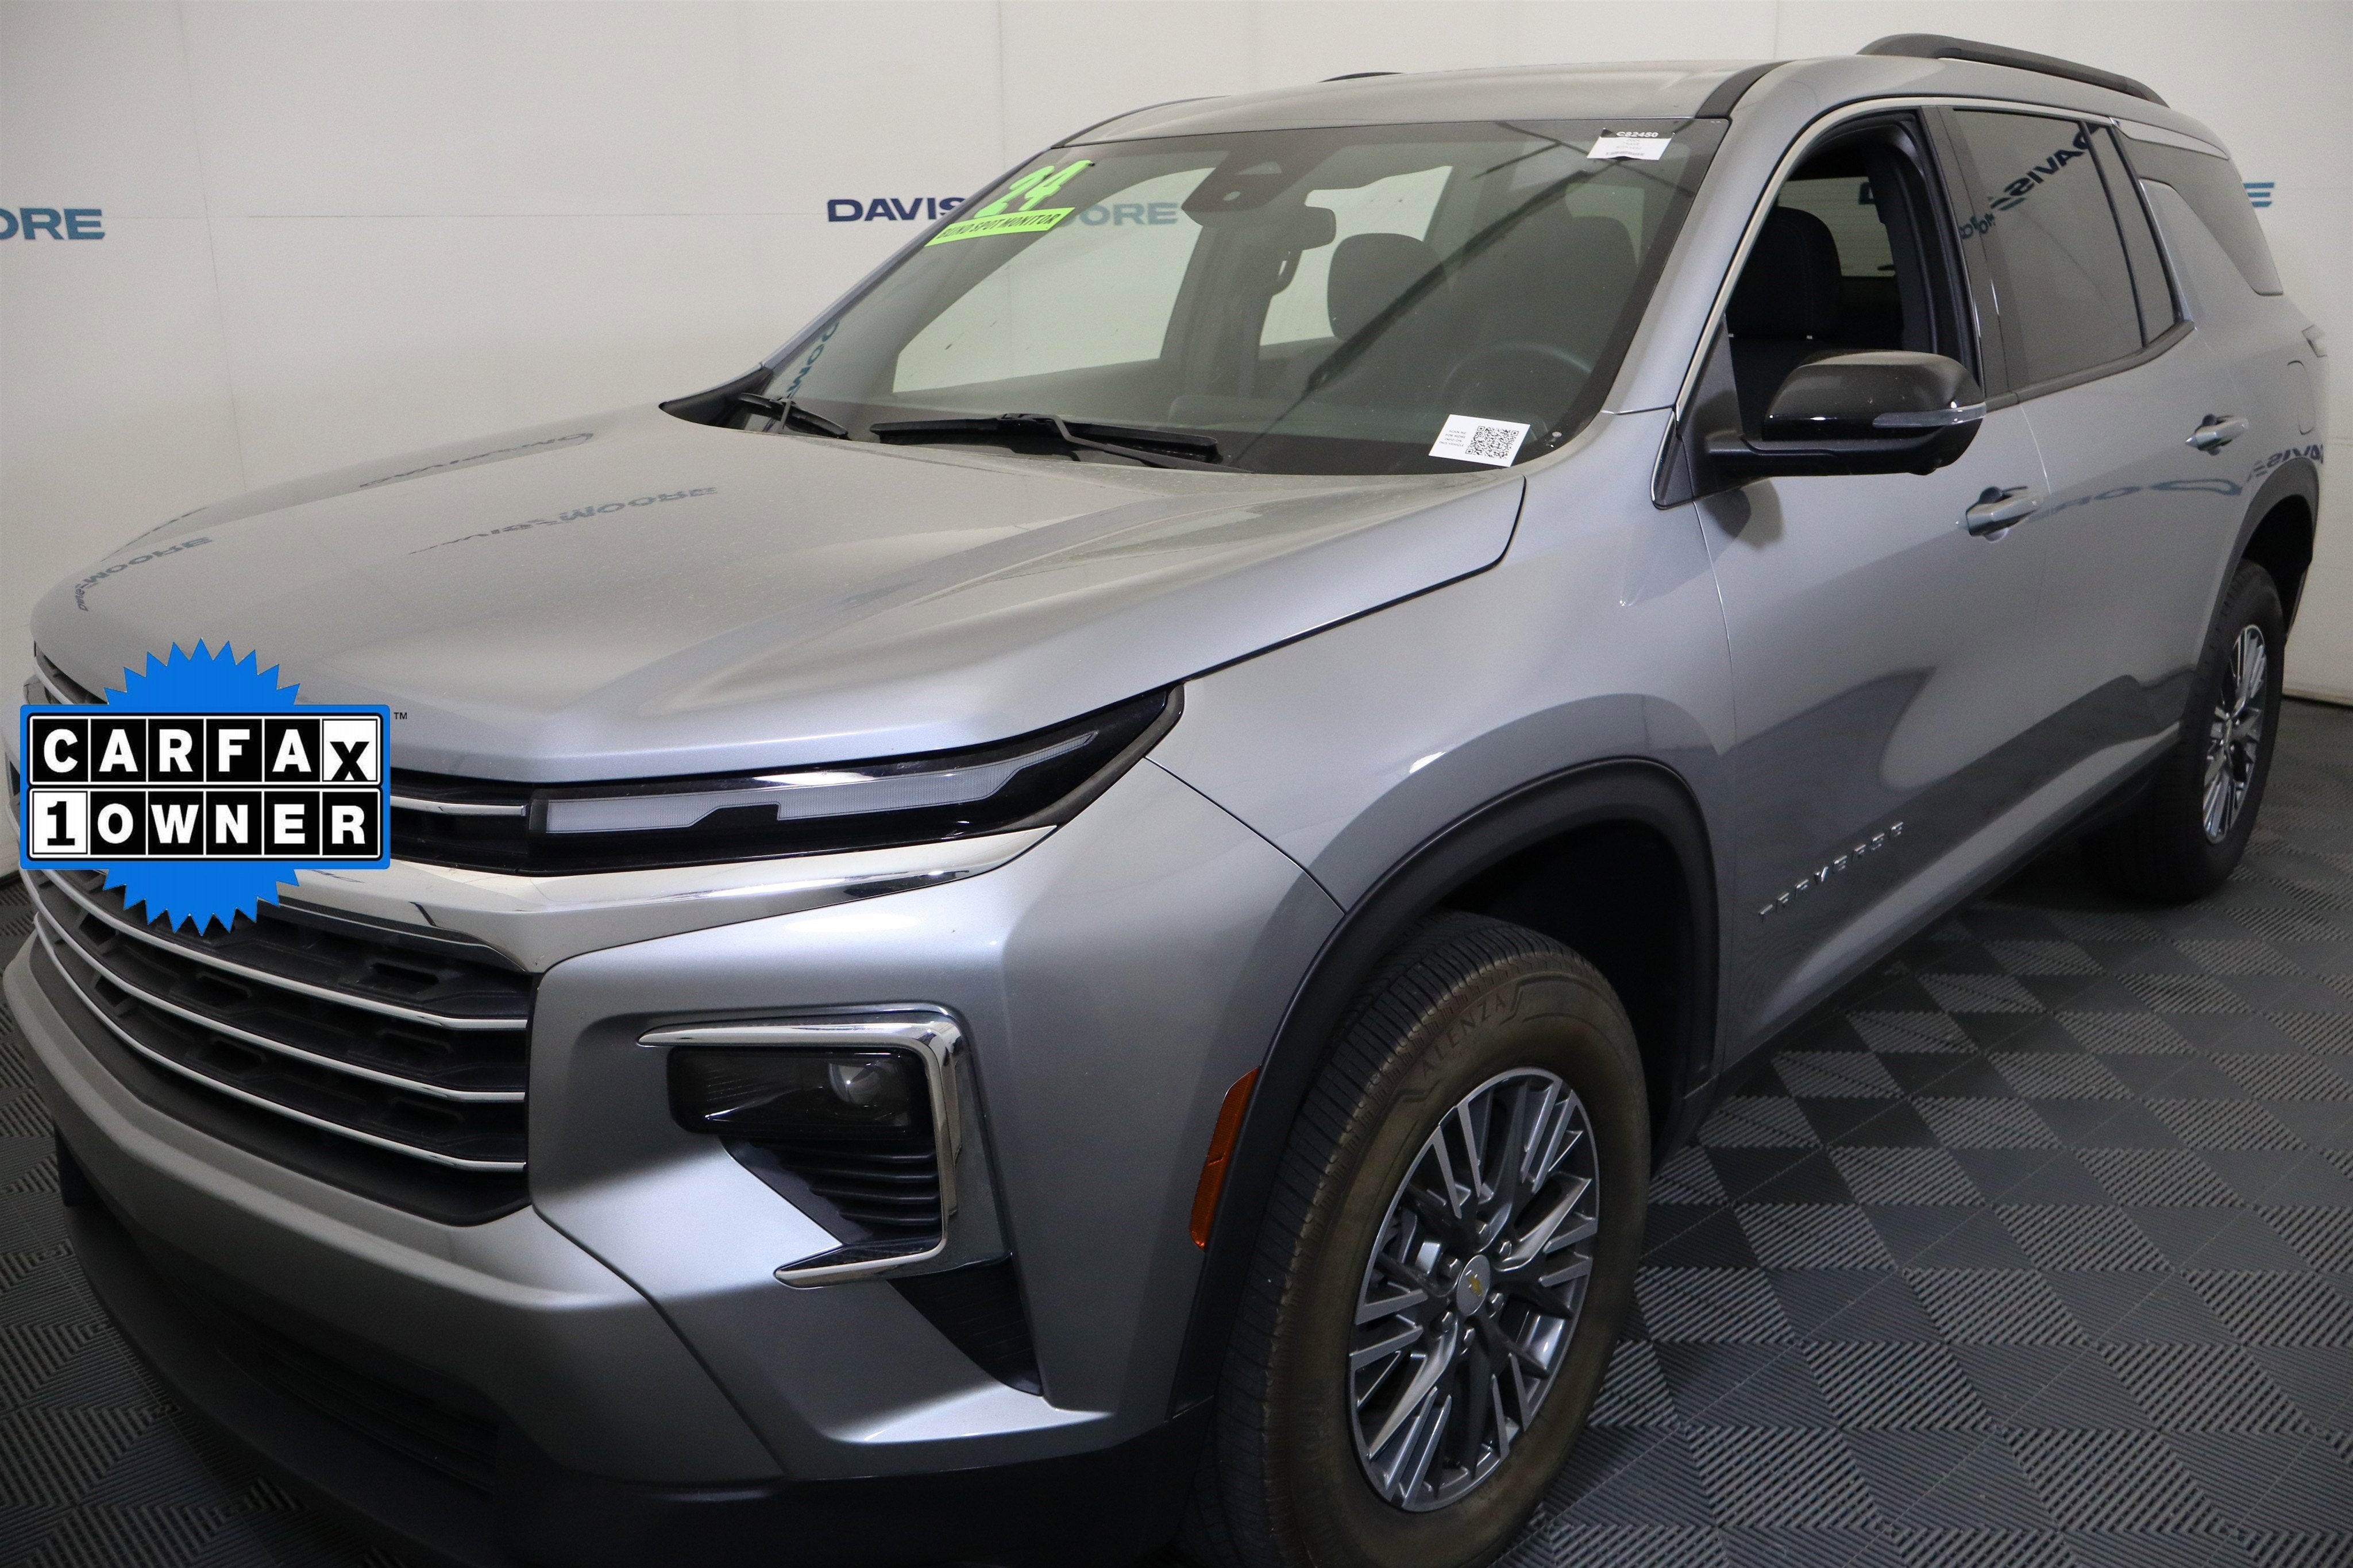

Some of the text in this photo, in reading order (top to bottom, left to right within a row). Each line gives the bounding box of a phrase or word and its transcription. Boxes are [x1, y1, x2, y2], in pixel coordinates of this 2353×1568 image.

[974, 160, 1093, 218] 24
[969, 218, 1006, 233] SPOT
[1000, 214, 1062, 228] MONITOR
[1062, 202, 1178, 226] ORE
[1421, 994, 1507, 1078] ALENZA
